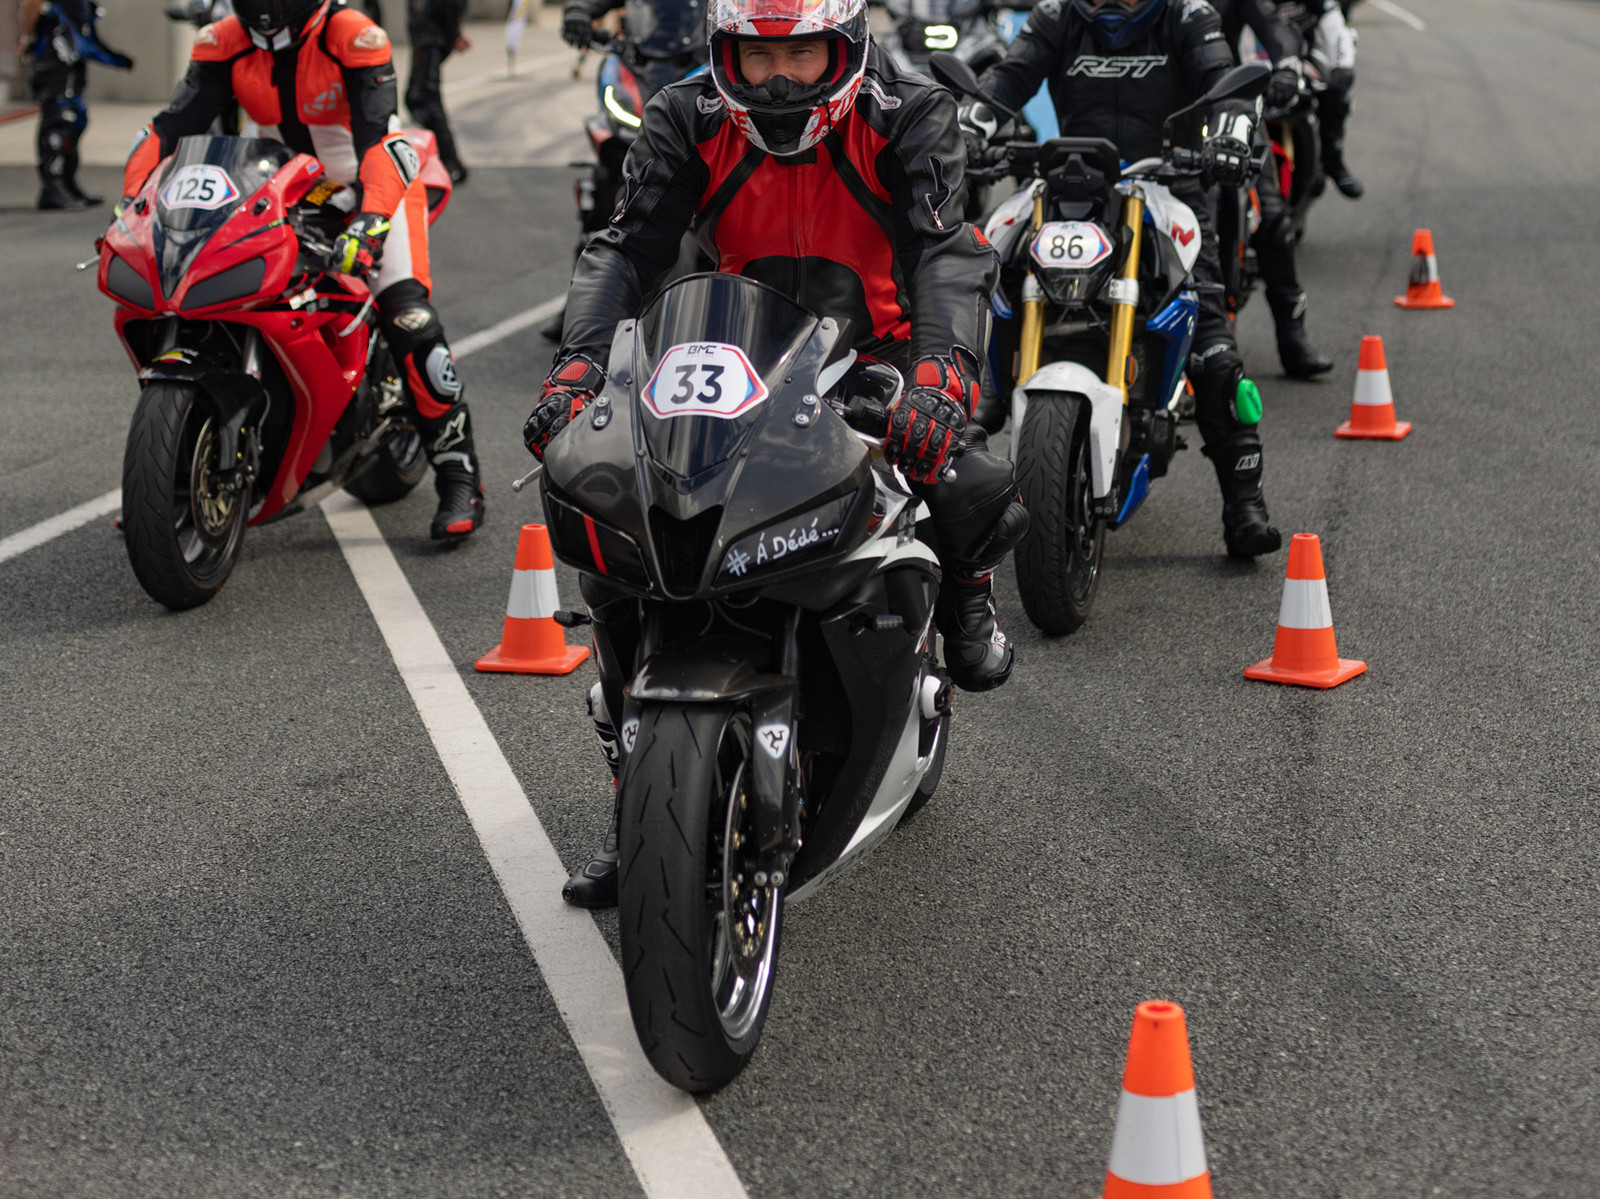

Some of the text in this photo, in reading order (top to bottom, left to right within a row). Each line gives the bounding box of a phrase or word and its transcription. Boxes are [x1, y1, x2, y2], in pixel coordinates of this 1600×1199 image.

[1066, 54, 1169, 78] RST
[174, 177, 217, 202] 125
[1049, 234, 1084, 260] 86
[670, 364, 725, 405] 33
